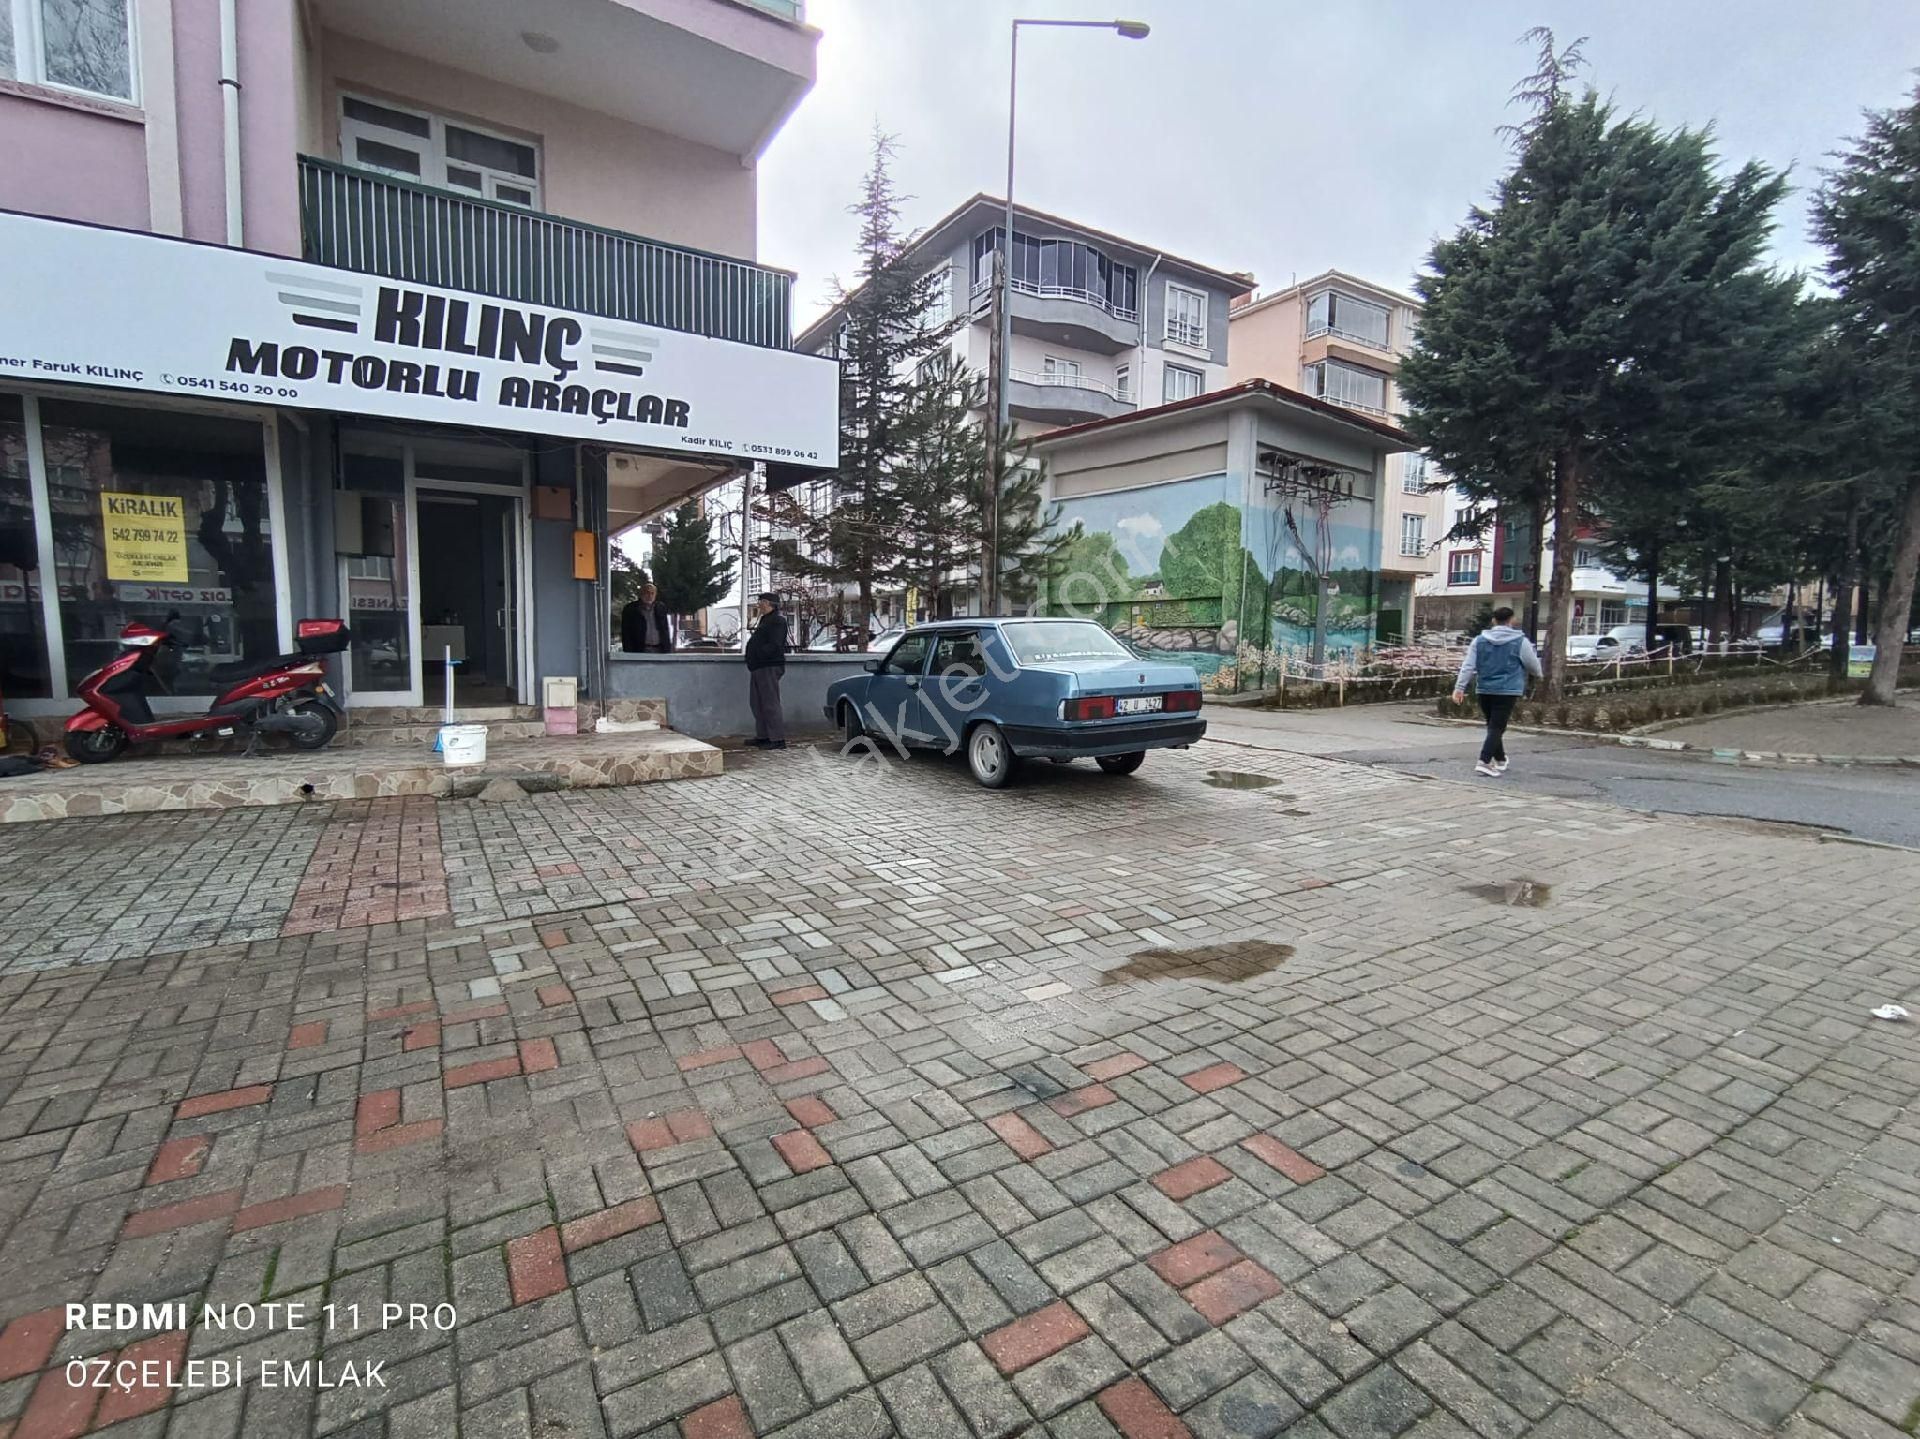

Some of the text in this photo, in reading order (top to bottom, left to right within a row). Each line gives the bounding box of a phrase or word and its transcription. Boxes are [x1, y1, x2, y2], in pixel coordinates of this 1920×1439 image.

[374, 286, 582, 382] KILINÇ
[32, 358, 82, 375] Faruk
[86, 364, 144, 383] KILINÇ
[177, 376, 298, 399] 0541 540 20 00
[225, 337, 691, 429] MOTORLU ARAÇLAR
[681, 435, 733, 451] Kadir KILIÇ
[112, 527, 131, 542] 542
[166, 530, 179, 544] 22
